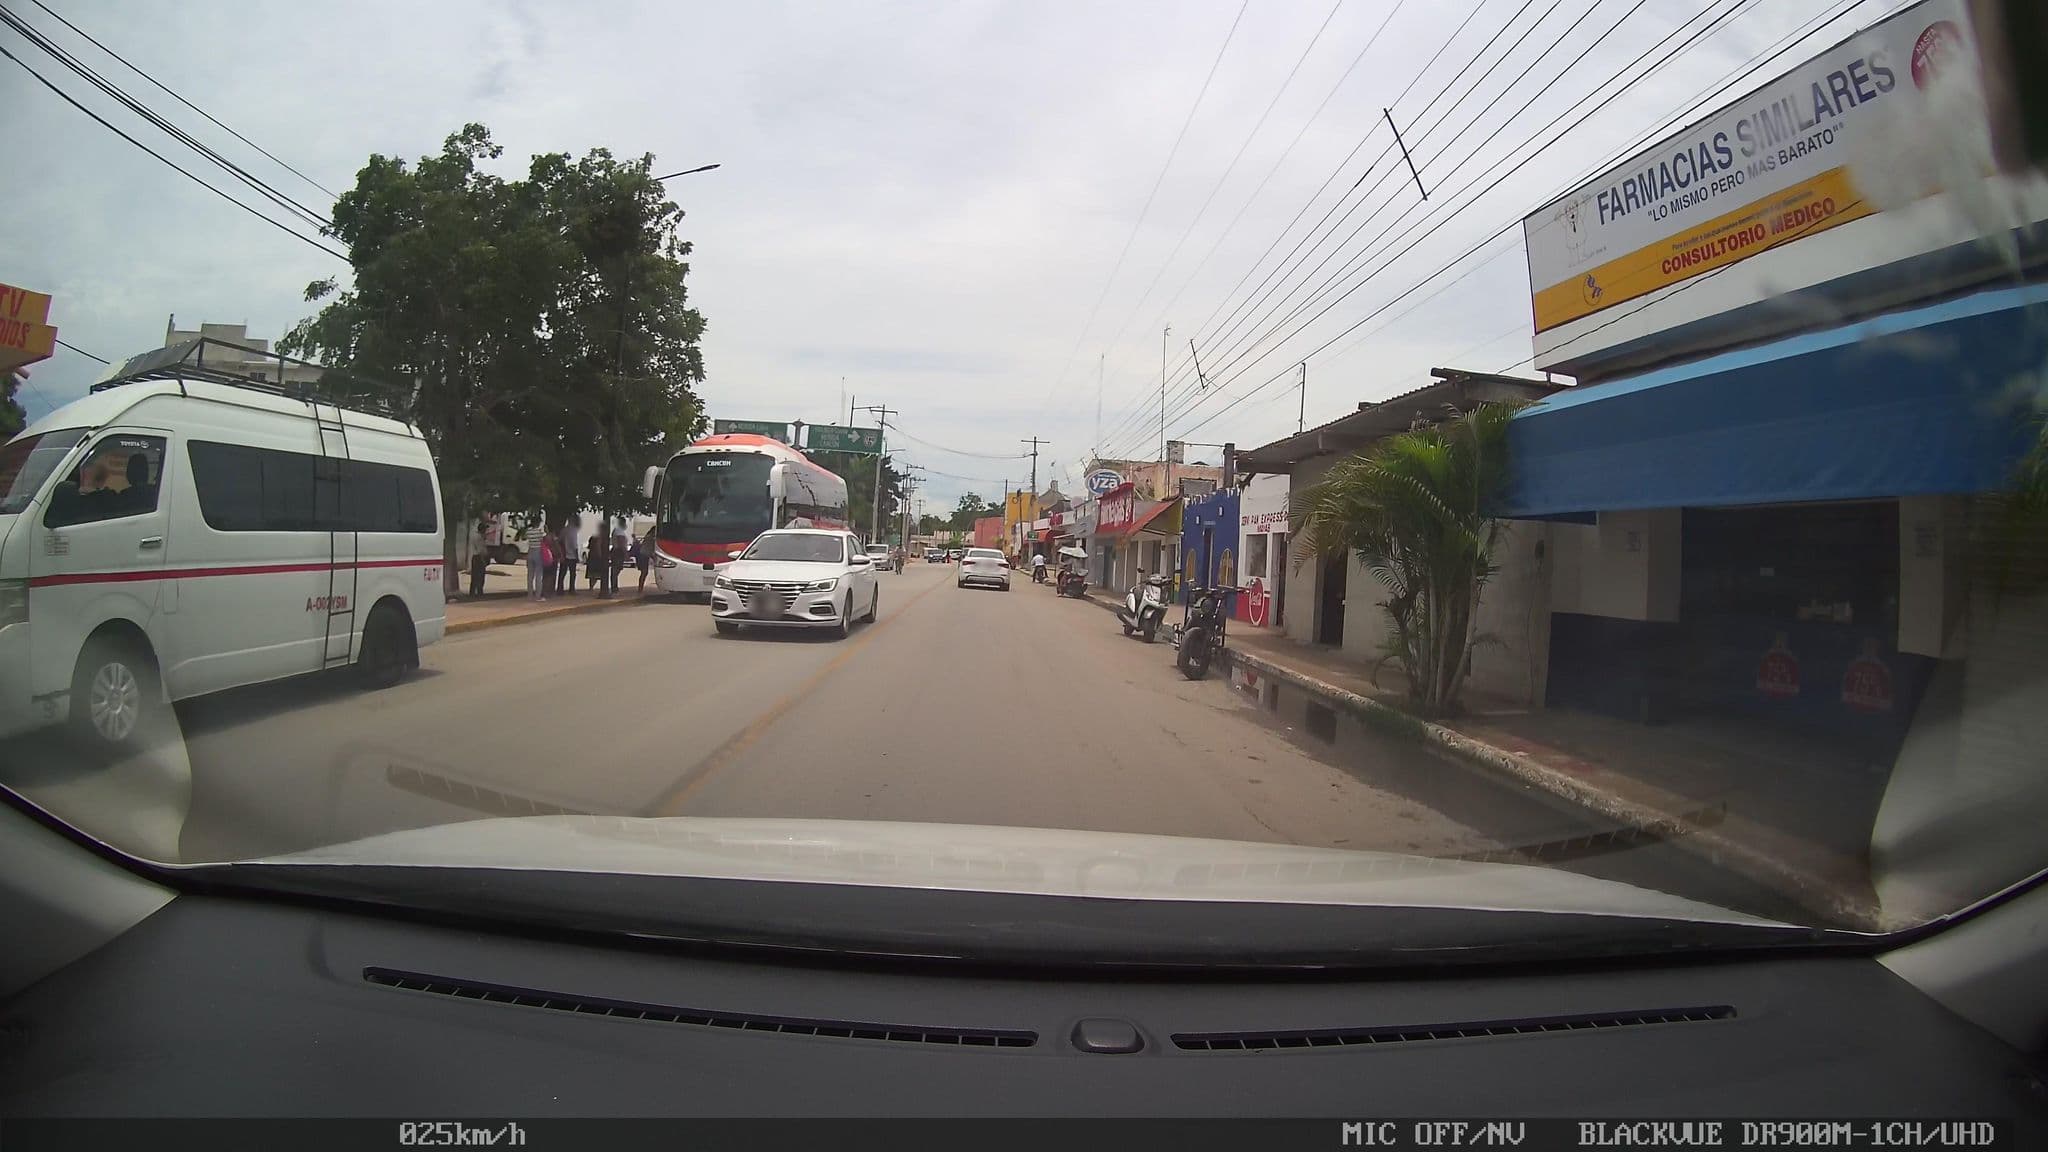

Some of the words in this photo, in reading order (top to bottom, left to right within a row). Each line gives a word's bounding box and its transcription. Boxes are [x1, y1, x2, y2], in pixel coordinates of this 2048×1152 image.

[1598, 131, 1733, 226] FARMACIAS
[1735, 50, 1896, 158] SIMILARES
[1671, 183, 1709, 217] MISMO
[1711, 169, 1745, 199] PERO
[1747, 154, 1777, 180] MAS
[1661, 222, 1767, 275] CONSULTORIO
[1770, 196, 1836, 236] MEDICO
[1092, 477, 1118, 490] yza
